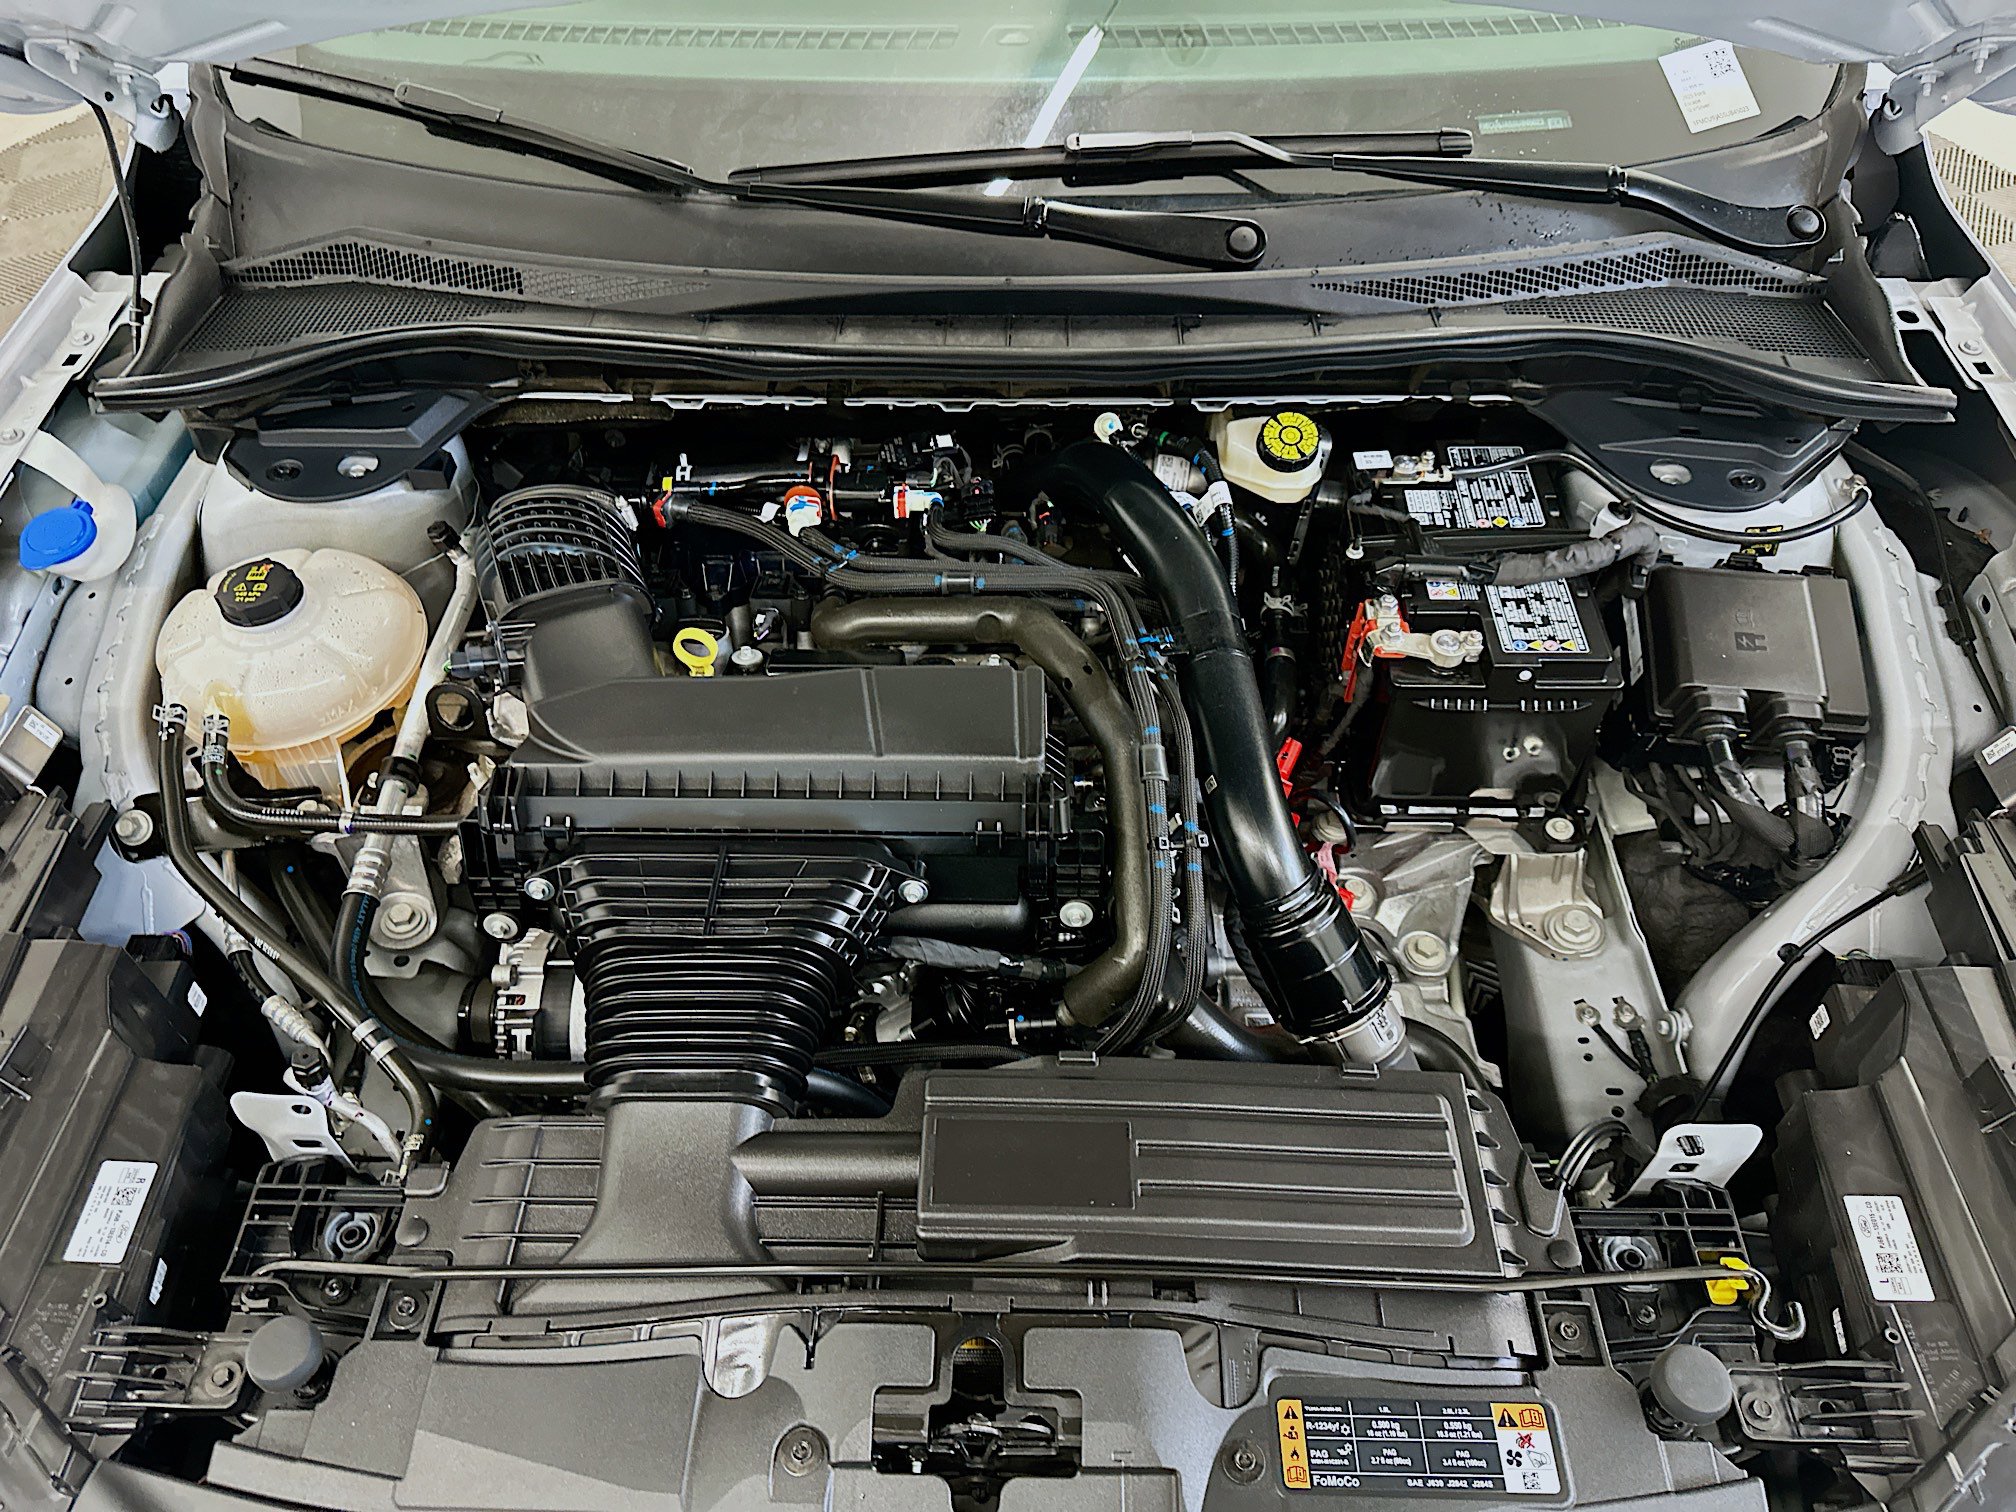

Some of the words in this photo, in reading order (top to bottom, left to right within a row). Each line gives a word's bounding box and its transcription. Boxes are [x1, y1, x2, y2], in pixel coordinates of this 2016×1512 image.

[1306, 1421, 1339, 1432] R-1234yf
[1310, 1450, 1329, 1459] PAG
[1313, 1475, 1360, 1487] FoMoCo
